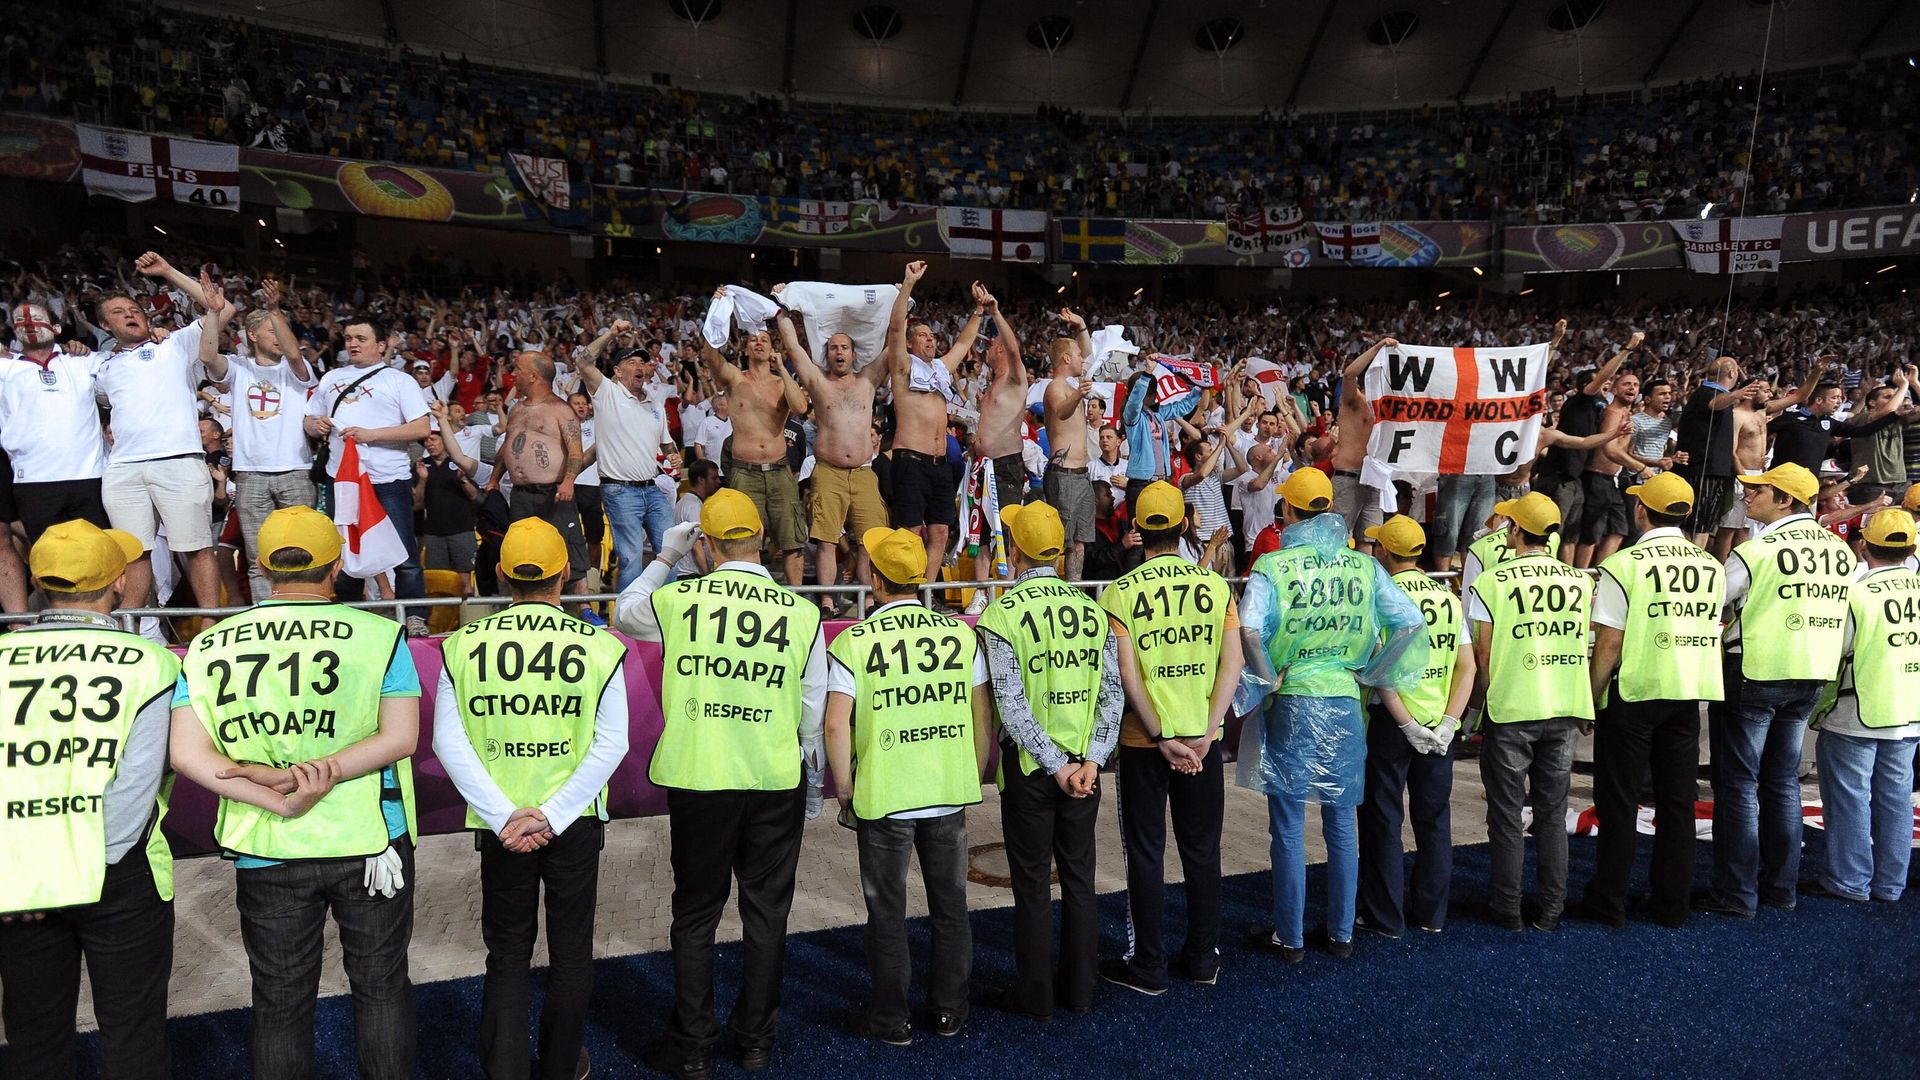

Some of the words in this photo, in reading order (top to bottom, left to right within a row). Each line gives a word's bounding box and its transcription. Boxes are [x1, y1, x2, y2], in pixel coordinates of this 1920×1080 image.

[127, 163, 198, 183] FELTS
[189, 188, 228, 206] 40
[1269, 207, 1299, 222] 6:57
[1227, 226, 1310, 250] PORTSMOUTH
[1754, 240, 1773, 250] FC
[1807, 213, 1920, 254] UEFA
[1734, 253, 1759, 262] OLD
[1389, 354, 1435, 393] W
[1489, 357, 1527, 393] W
[1464, 394, 1543, 420] WOLVS
[1387, 430, 1416, 464] F
[1494, 430, 1520, 466] C
[1495, 566, 1583, 582] STEWARD
[1777, 548, 1850, 576] 0318
[1645, 565, 1716, 592] 1207
[678, 580, 795, 607] STEWARD
[1132, 584, 1214, 622] 4176
[1288, 576, 1364, 610] 2806
[1508, 584, 1582, 614] 1202
[1778, 584, 1848, 602] СТЮАРД
[1420, 598, 1453, 626] 61
[1884, 597, 1920, 624] 04
[200, 620, 353, 652] STEWARD
[465, 614, 596, 636] STEWARD
[682, 604, 790, 653] 1194
[851, 614, 959, 637] STEWARD
[1020, 606, 1099, 644] 1195
[0, 644, 144, 665] TEWARD
[469, 641, 586, 684] 1046
[866, 636, 964, 678] 4132
[207, 650, 340, 707] 2713
[676, 655, 786, 688] СТЮАРД
[1158, 663, 1206, 678] RESPEC
[0, 674, 122, 725] 733
[469, 694, 582, 718] СТЮАРД
[872, 682, 966, 710] СТЮАРД
[219, 709, 336, 743] СТЮАРД
[704, 703, 772, 722] RESPECT
[900, 724, 965, 744] RESPECT
[0, 737, 118, 768] ЮАРД
[504, 738, 572, 758] RESPEC
